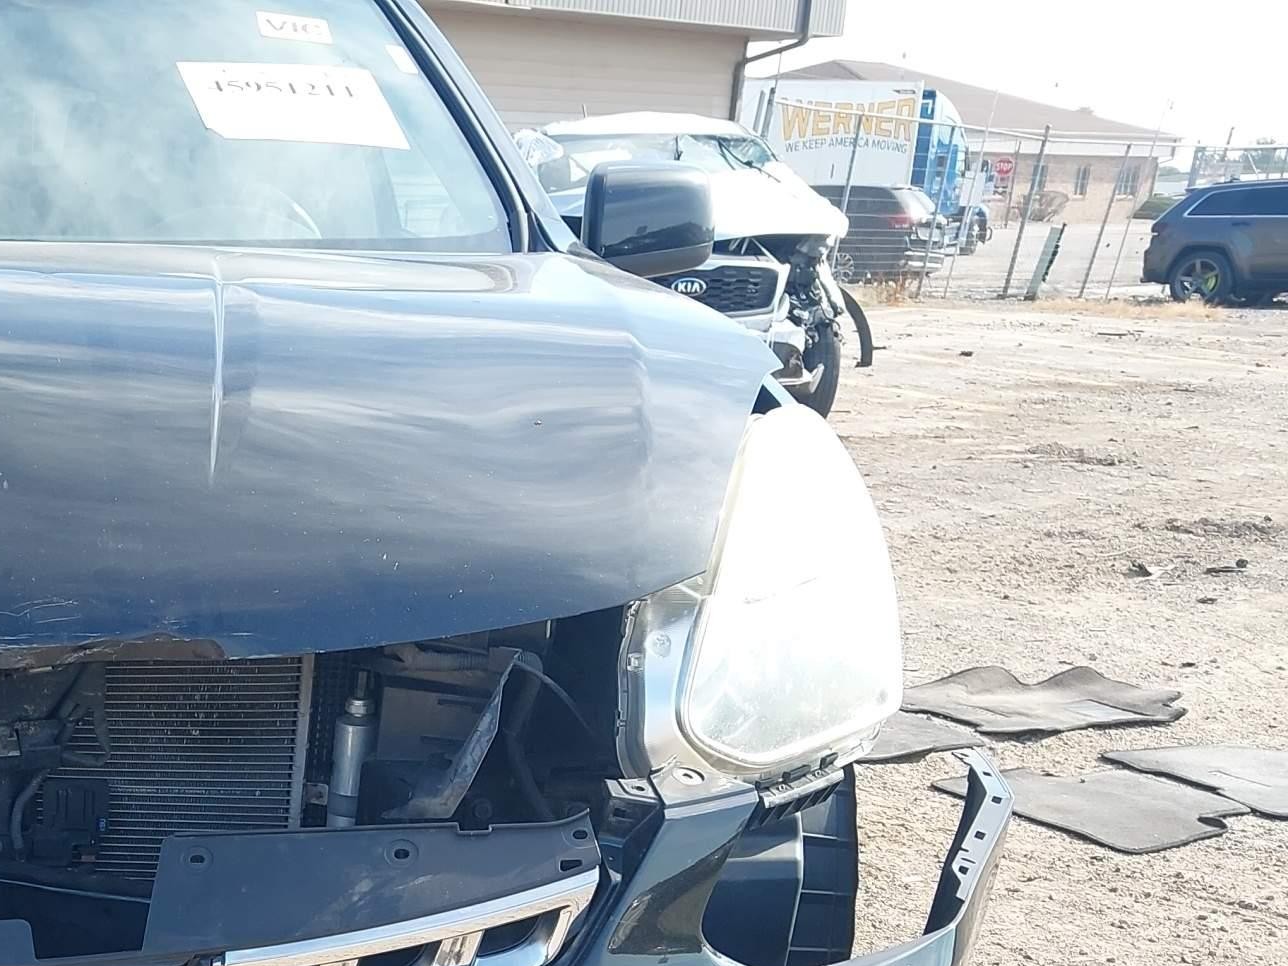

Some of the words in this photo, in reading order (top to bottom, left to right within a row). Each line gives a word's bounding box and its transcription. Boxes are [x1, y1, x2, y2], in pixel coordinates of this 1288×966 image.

[781, 97, 916, 142] WERNER
[785, 142, 800, 153] WE
[802, 138, 827, 150] KEEP
[828, 136, 869, 148] AMERCA
[871, 139, 908, 154] MOVING
[996, 161, 1013, 172] STOP
[677, 281, 701, 293] KIA
